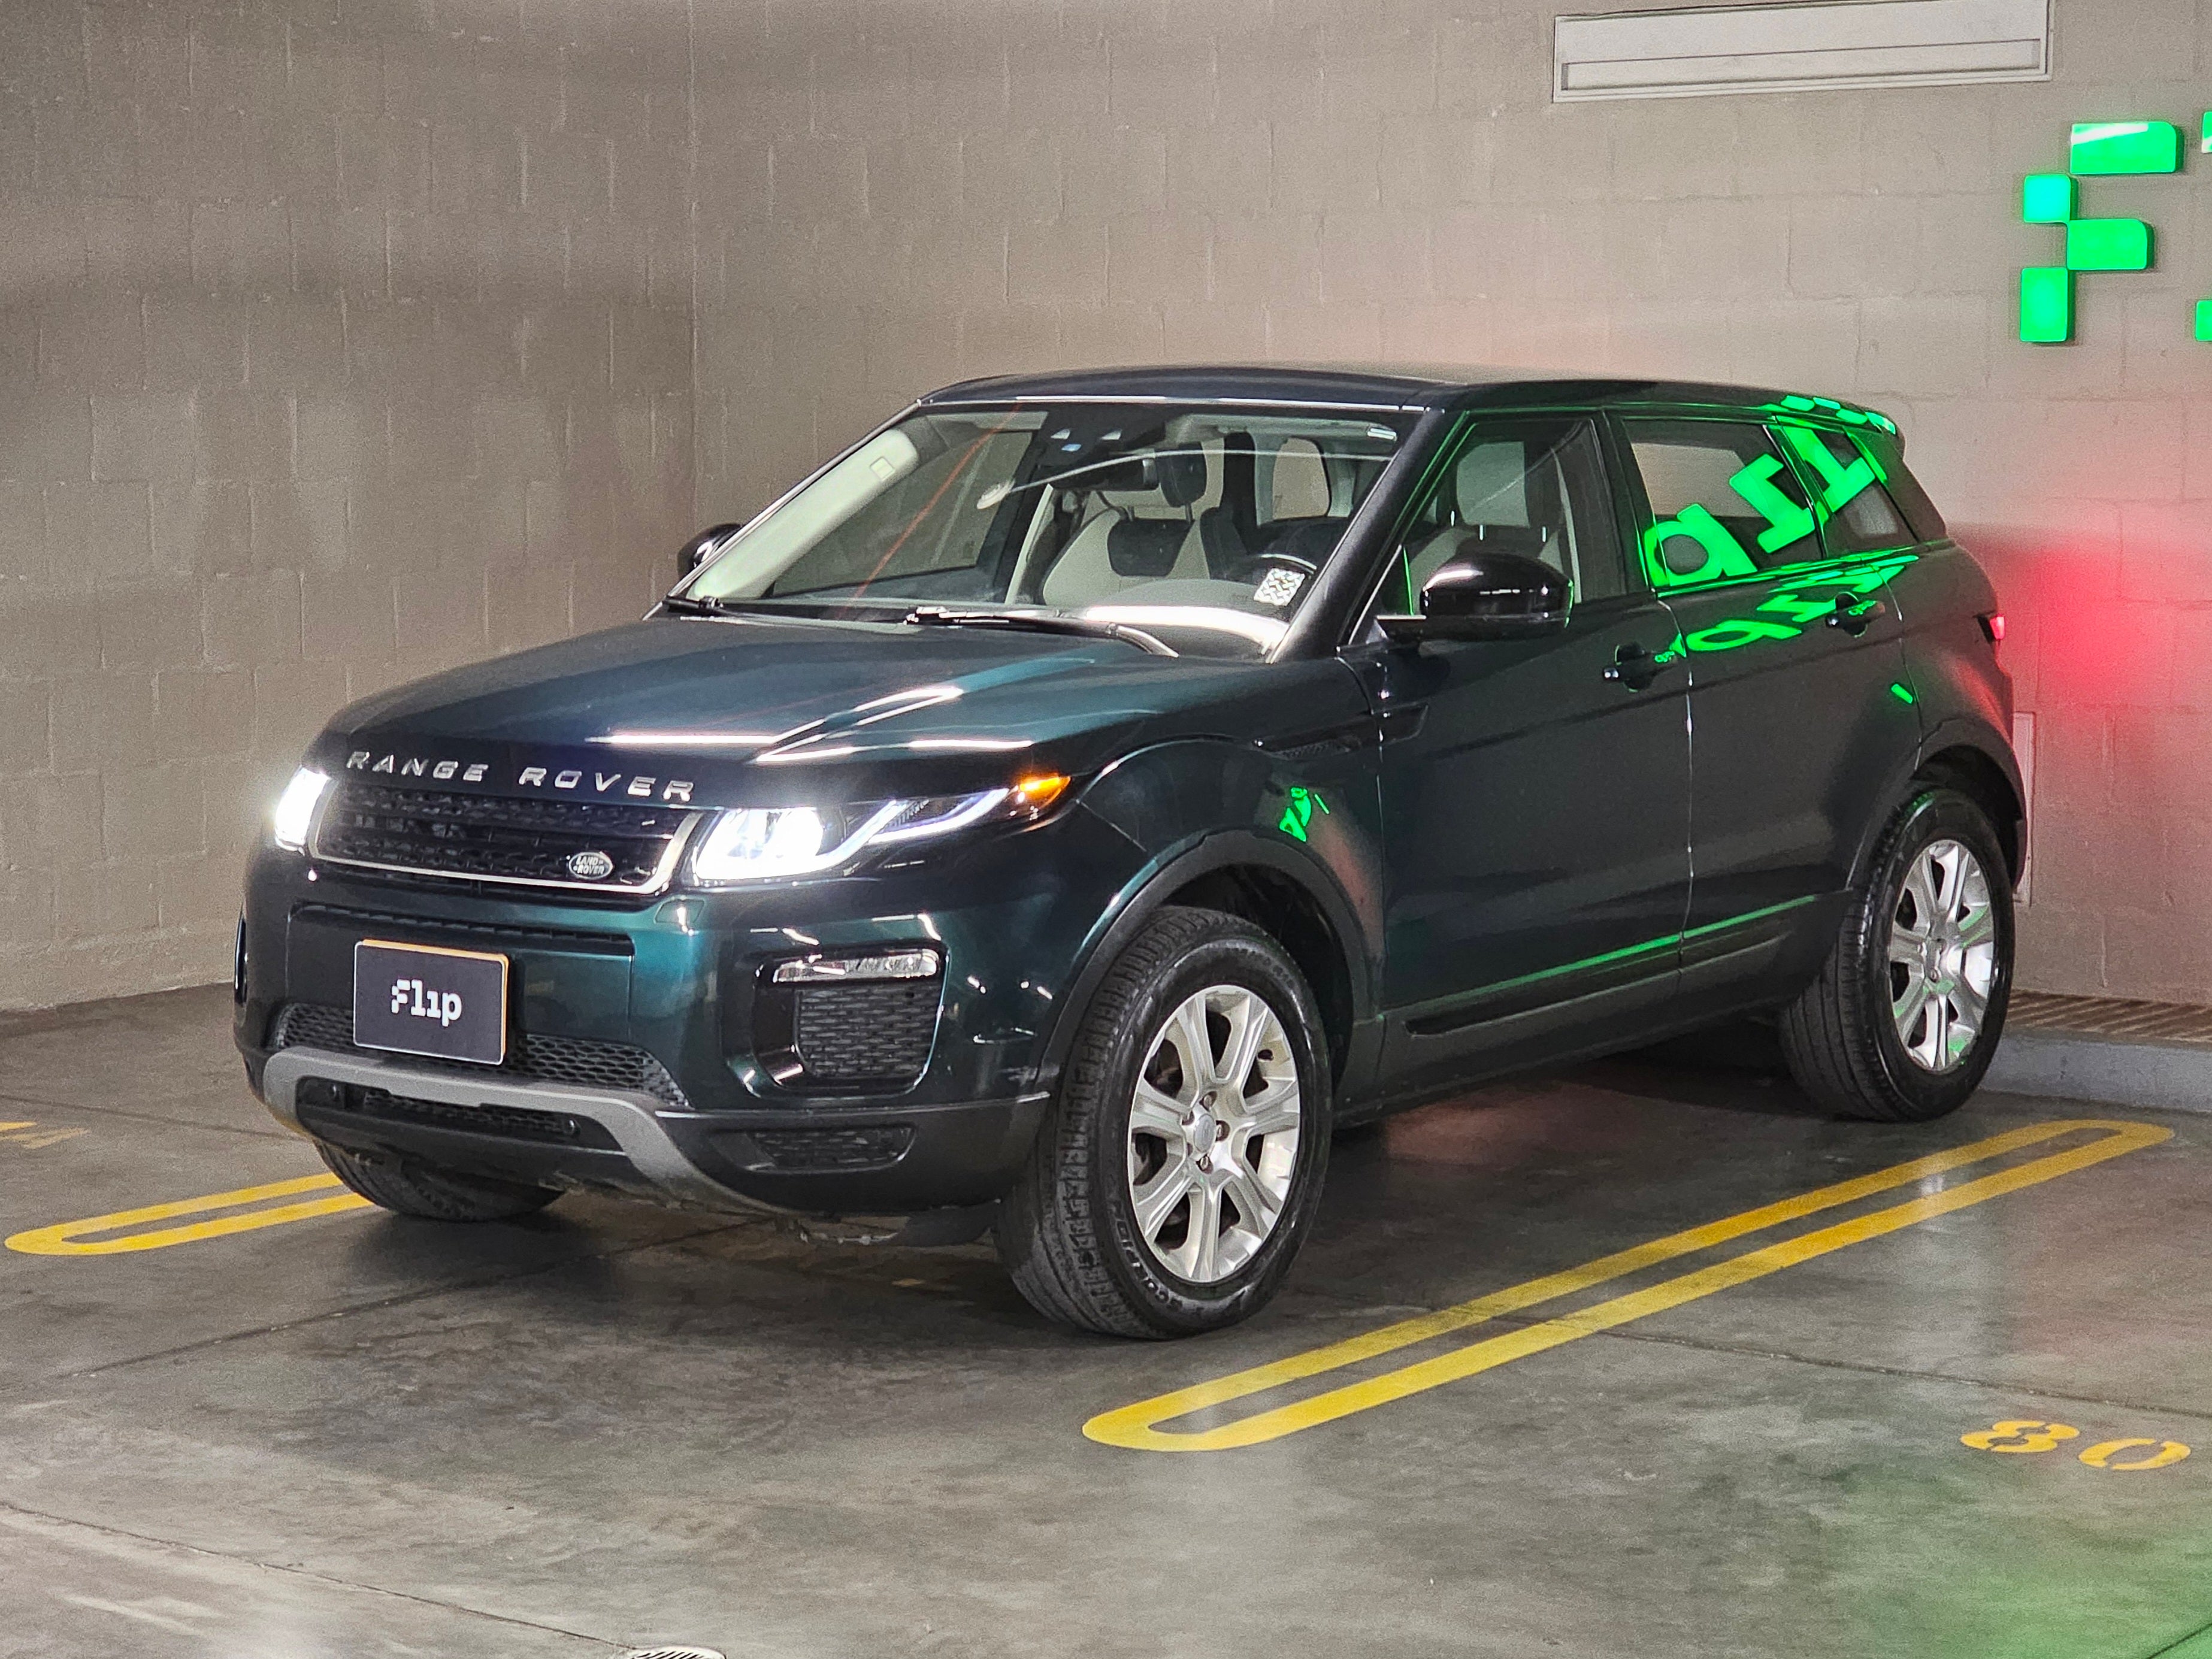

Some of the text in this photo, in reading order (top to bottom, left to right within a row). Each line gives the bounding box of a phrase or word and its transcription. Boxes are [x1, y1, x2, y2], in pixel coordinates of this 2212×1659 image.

[346, 750, 695, 803] RANGE ROVER
[576, 855, 599, 866] LAND
[576, 864, 605, 875] ROVER
[1960, 1419, 2192, 1471] 80
